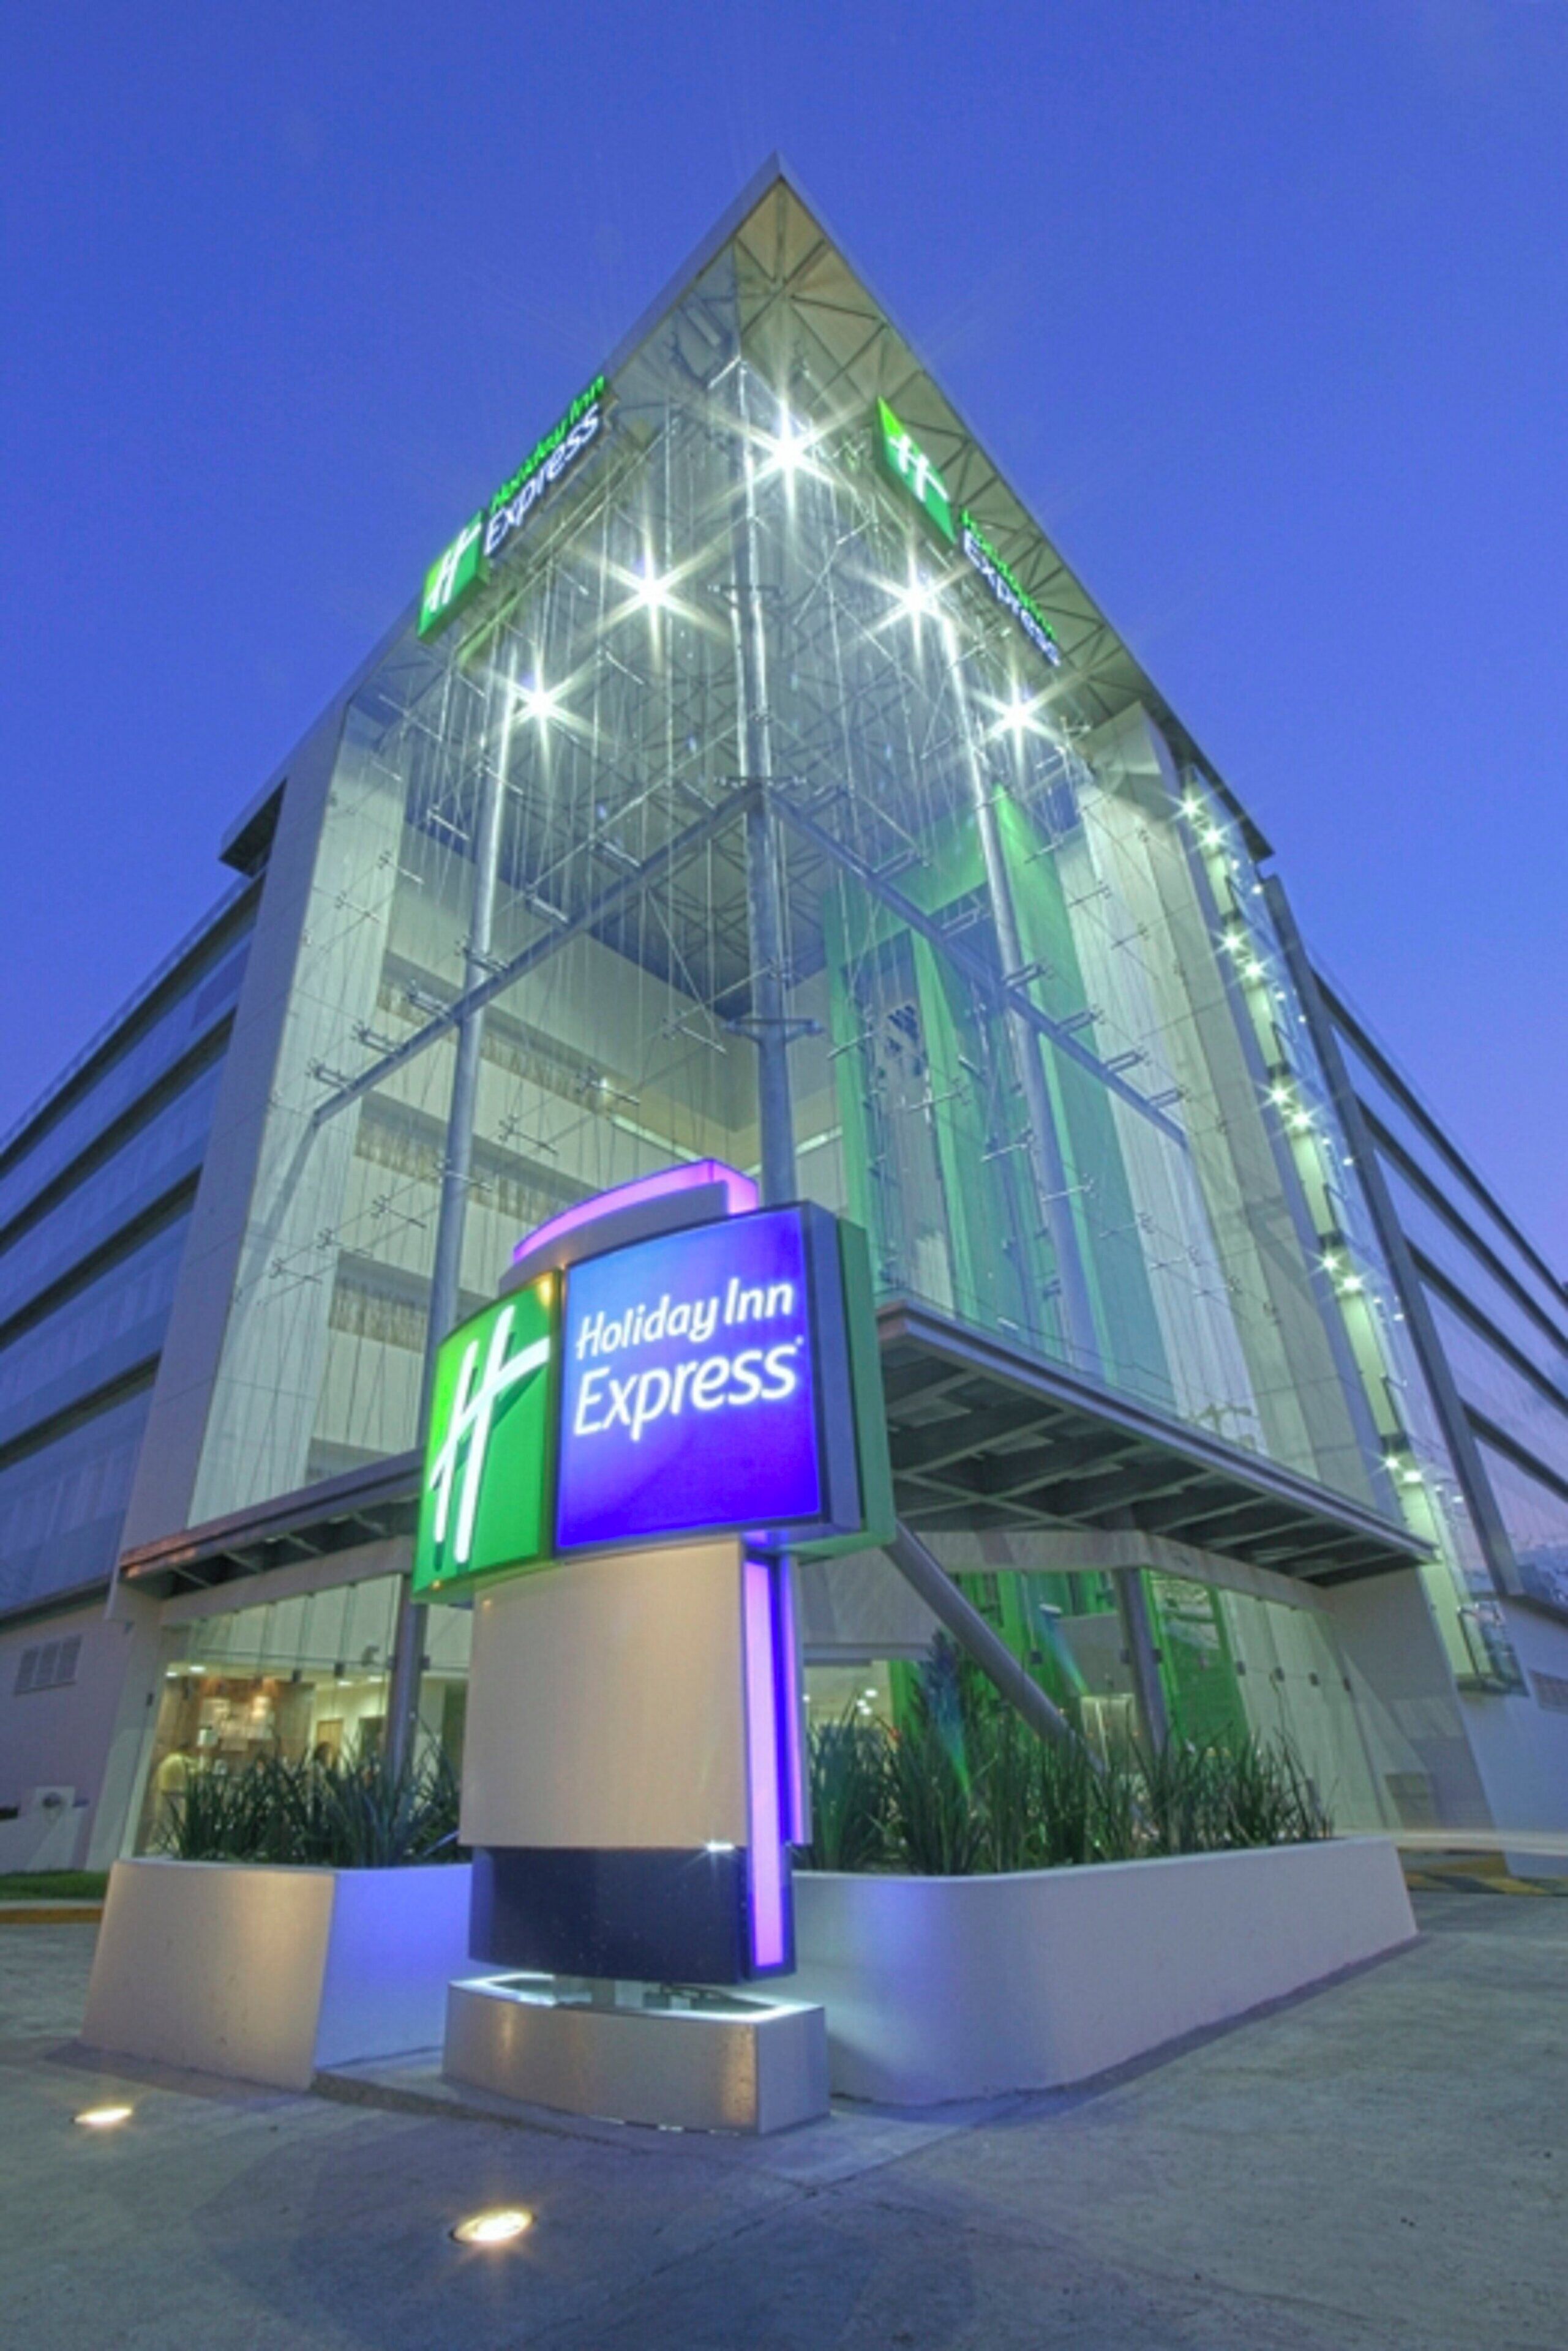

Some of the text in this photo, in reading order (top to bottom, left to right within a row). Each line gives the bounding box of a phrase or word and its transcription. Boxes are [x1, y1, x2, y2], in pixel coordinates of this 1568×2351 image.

[484, 402, 599, 556] Express
[576, 1277, 793, 1360] Holiday Inn
[573, 1343, 798, 1442] Express
